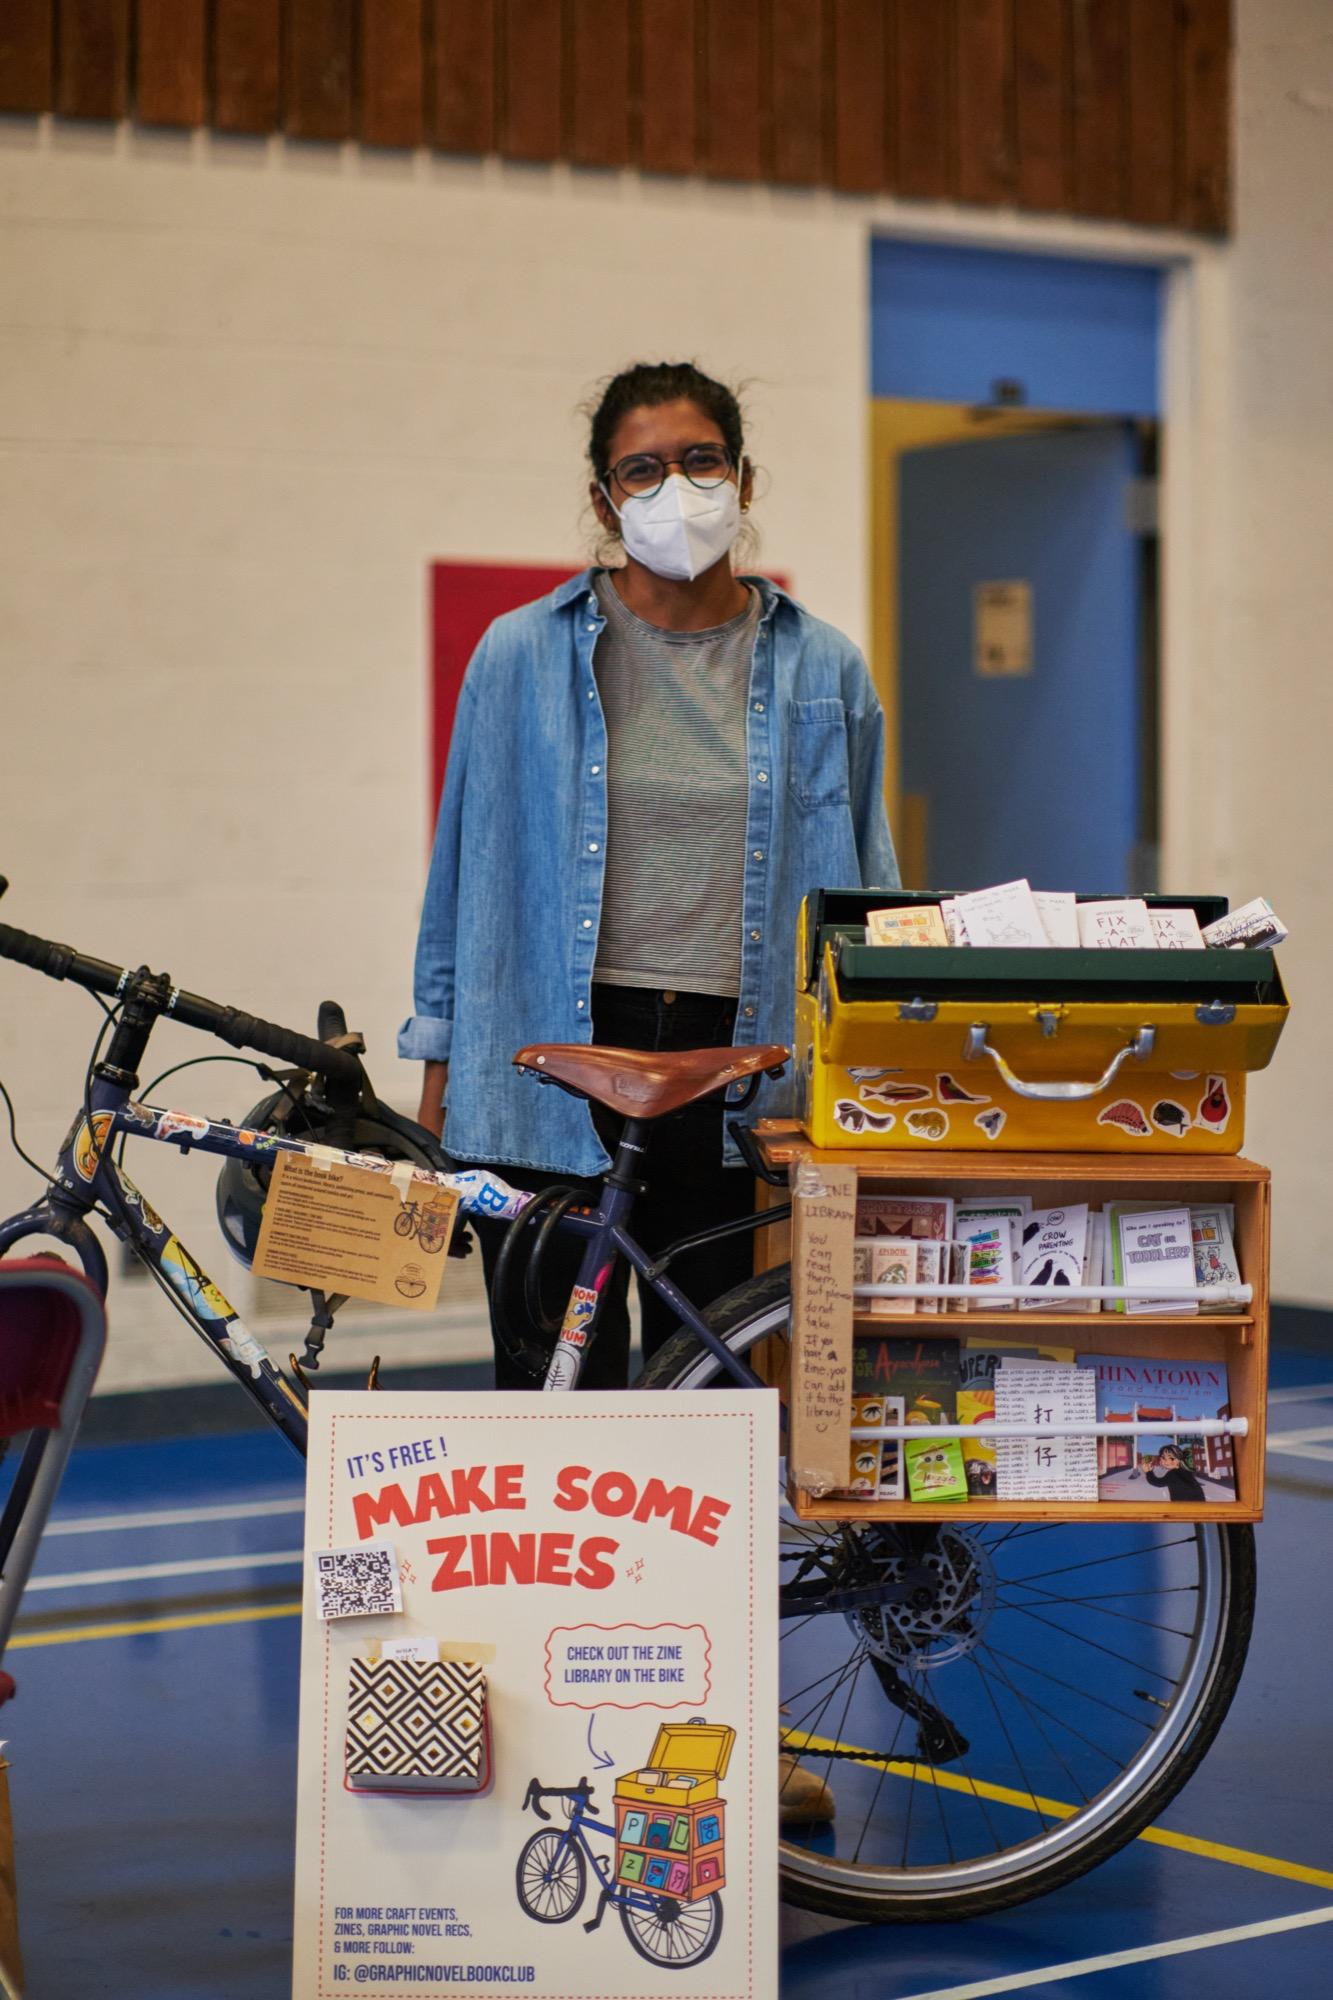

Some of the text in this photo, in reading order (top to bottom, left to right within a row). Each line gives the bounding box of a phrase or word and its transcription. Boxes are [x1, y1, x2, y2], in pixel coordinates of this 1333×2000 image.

[1097, 916, 1127, 928] FIX
[1042, 1230, 1066, 1241] CROW
[1137, 1233, 1162, 1247] CAT
[1039, 1238, 1074, 1250] PARENTING
[573, 1287, 596, 1303] NOM
[561, 1329, 585, 1345] YUM
[1034, 1403, 1057, 1467] 打仔
[347, 1451, 385, 1479] IT'S
[352, 1464, 732, 1547] MAKE SOME
[426, 1531, 620, 1592] ZINES
[567, 1646, 682, 1660] CHECK OUT THE ZINE
[564, 1668, 685, 1683] LIBRARY ON THE BIKE
[335, 1907, 458, 1921] FOR MORE CRAFT EVENTS,
[334, 1923, 472, 1938] ZINES, GRAPHIC NOVEL RECS,
[334, 1941, 415, 1954] & MORE FOLLOW:
[333, 1964, 535, 1982] IG: @GRAPHICNOVELBOOKCLUB
